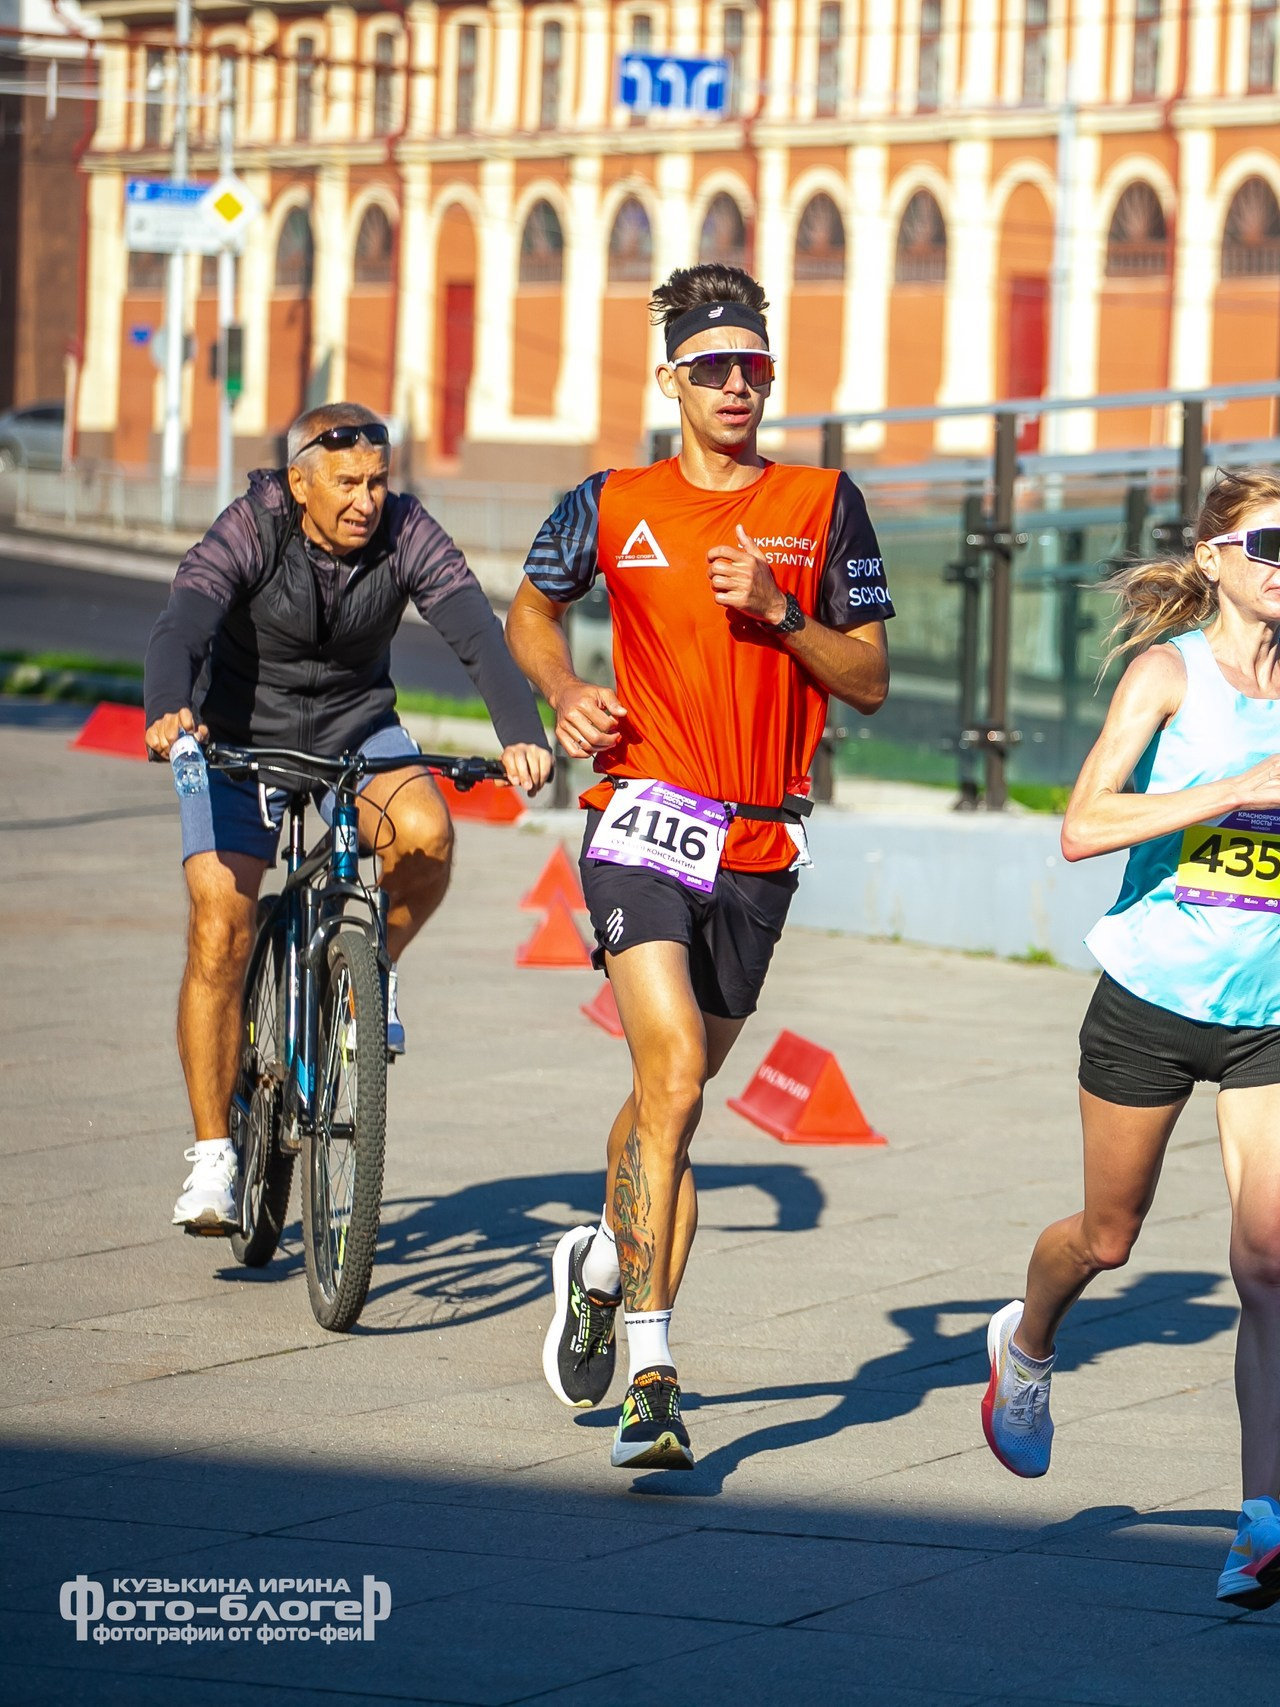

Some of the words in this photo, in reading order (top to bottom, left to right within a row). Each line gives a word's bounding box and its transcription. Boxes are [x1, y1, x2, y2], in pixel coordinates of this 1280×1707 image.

[738, 536, 818, 551] KHACHEV
[765, 552, 815, 569] STANTIN
[847, 558, 882, 578] SPOR
[1251, 819, 1273, 827] МОСТЫ
[611, 805, 708, 861] 4116
[646, 847, 696, 870] КОНСТАНТИН
